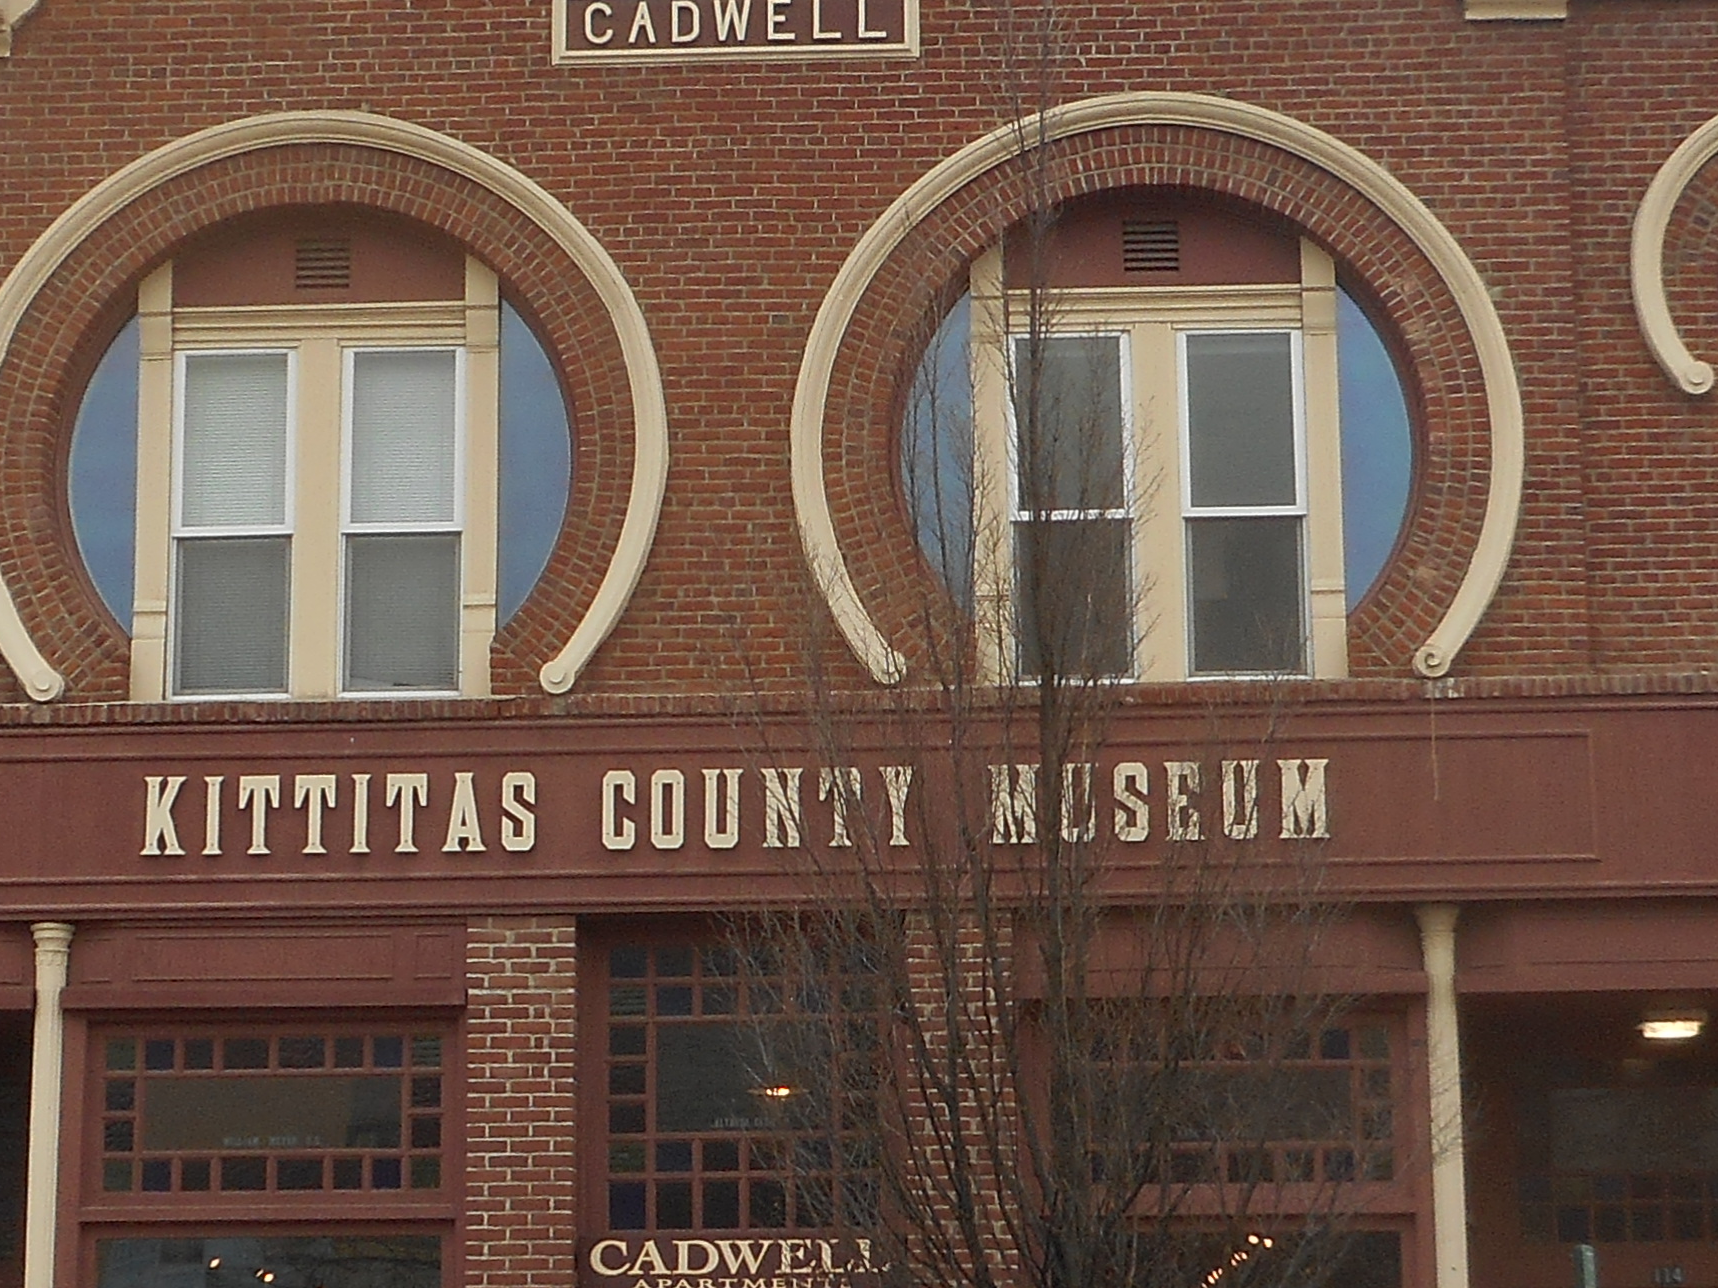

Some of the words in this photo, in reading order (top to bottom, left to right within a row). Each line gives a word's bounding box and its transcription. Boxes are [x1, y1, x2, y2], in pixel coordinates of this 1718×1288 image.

[139, 771, 536, 856] KITTITAS
[601, 765, 916, 850] COUNTY
[988, 759, 1331, 845] MUSEUM
[589, 1238, 892, 1277] CADWELL
